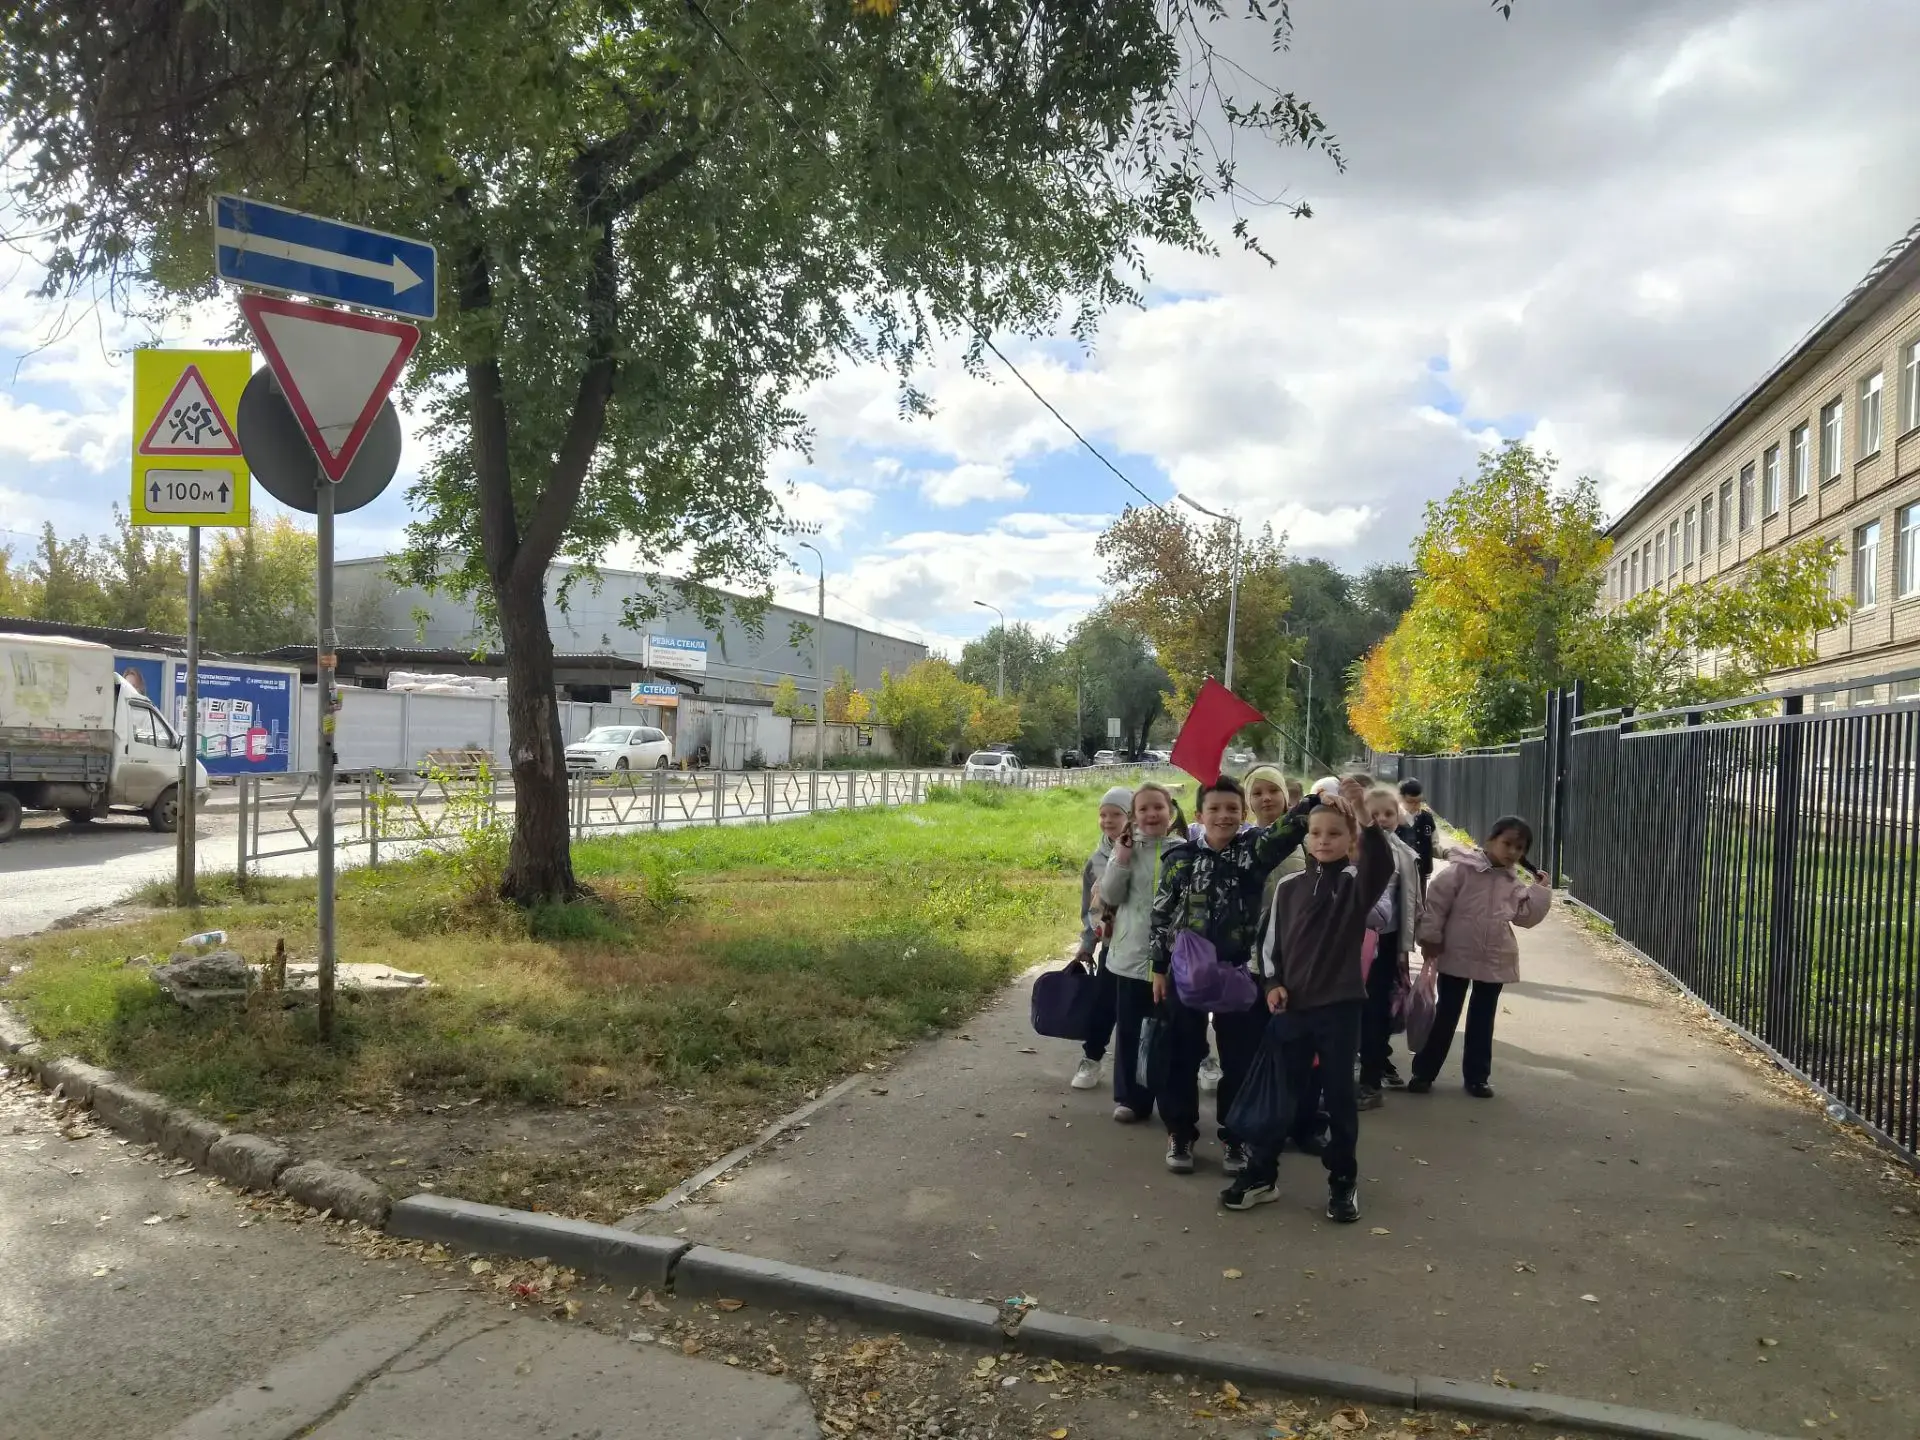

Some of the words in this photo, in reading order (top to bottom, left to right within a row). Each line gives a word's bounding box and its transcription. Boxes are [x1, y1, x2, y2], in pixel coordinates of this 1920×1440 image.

[166, 482, 214, 501] 100м
[652, 636, 676, 647] РЕЗКА
[676, 639, 706, 650] СТЕКЛА
[643, 685, 677, 695] СТЕКЛО
